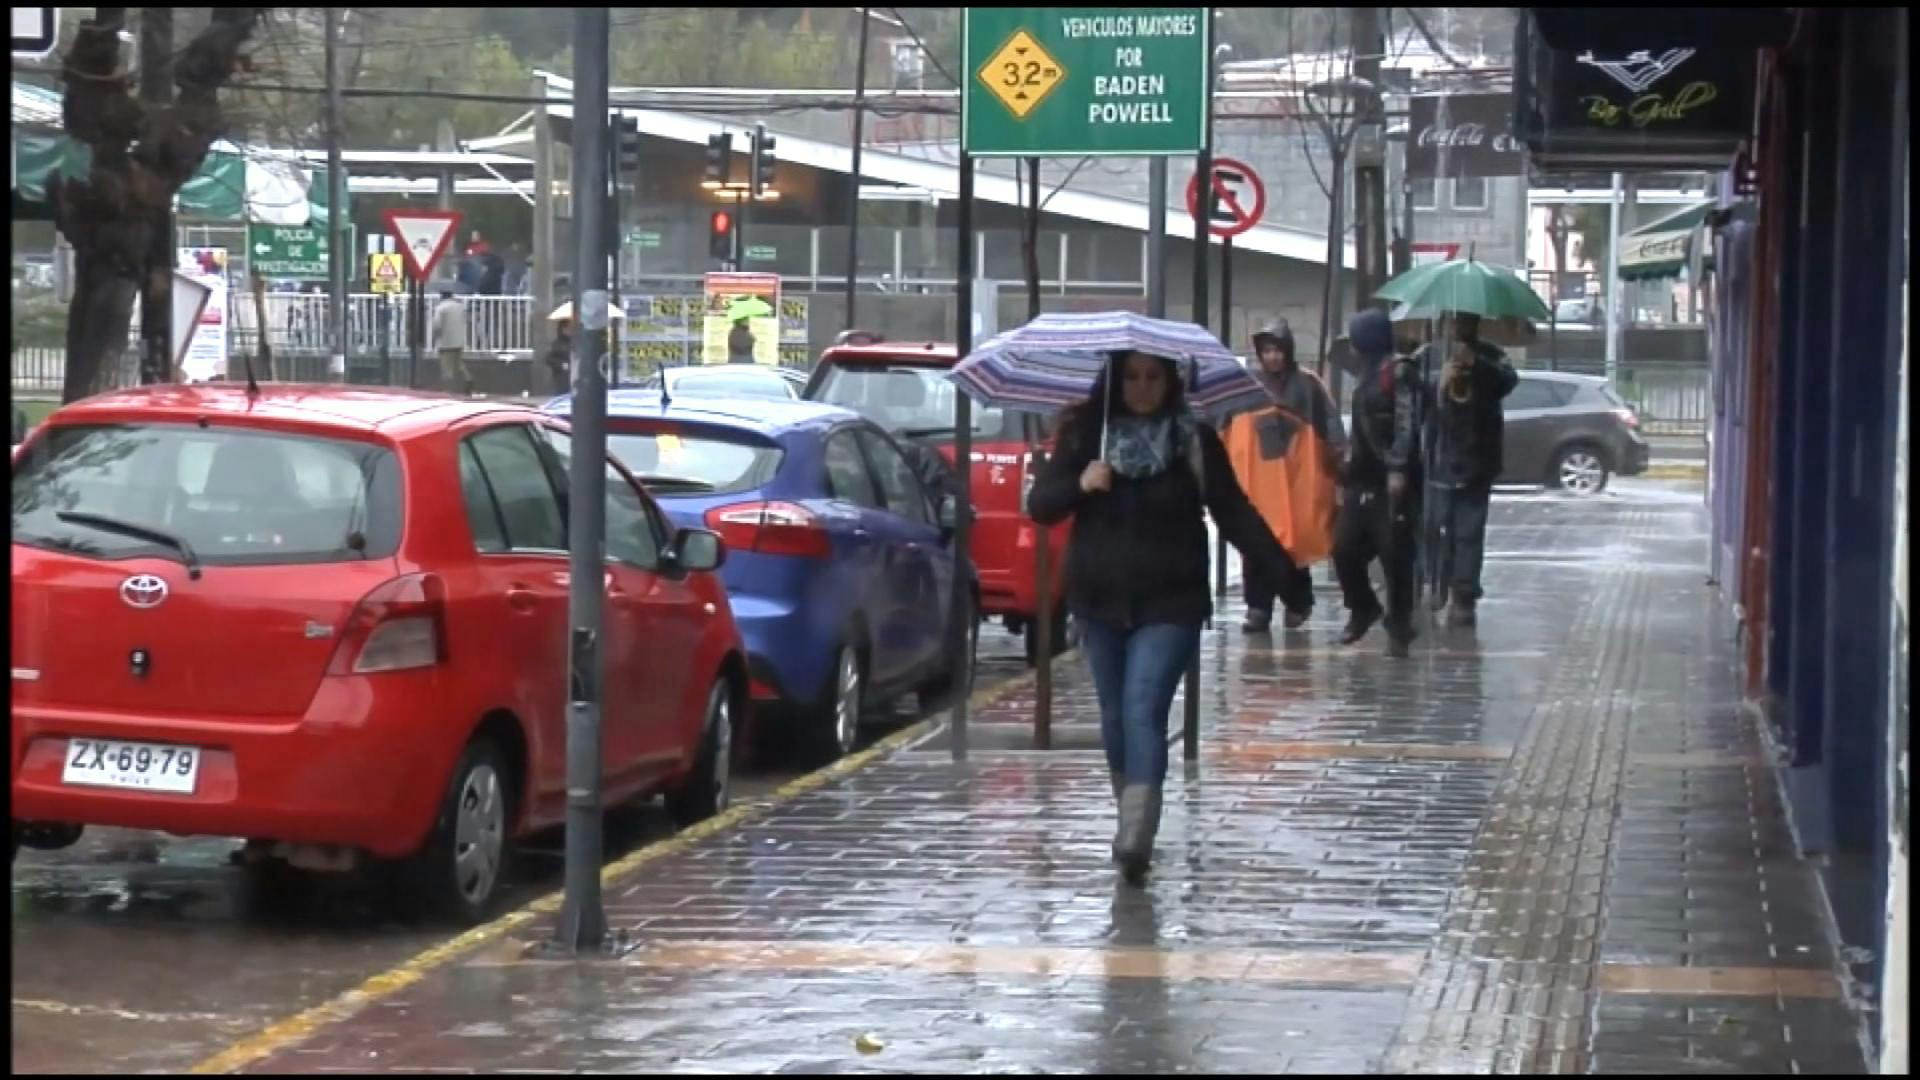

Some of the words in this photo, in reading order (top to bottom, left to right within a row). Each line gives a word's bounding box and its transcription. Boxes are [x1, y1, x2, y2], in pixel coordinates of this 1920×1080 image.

[1062, 18, 1134, 38] VEHICULOS
[1135, 15, 1196, 36] MAYORES
[1115, 46, 1142, 67] POR
[1095, 75, 1164, 95] BADEN
[1089, 103, 1173, 123] POWELL
[1628, 81, 1717, 127] Grill
